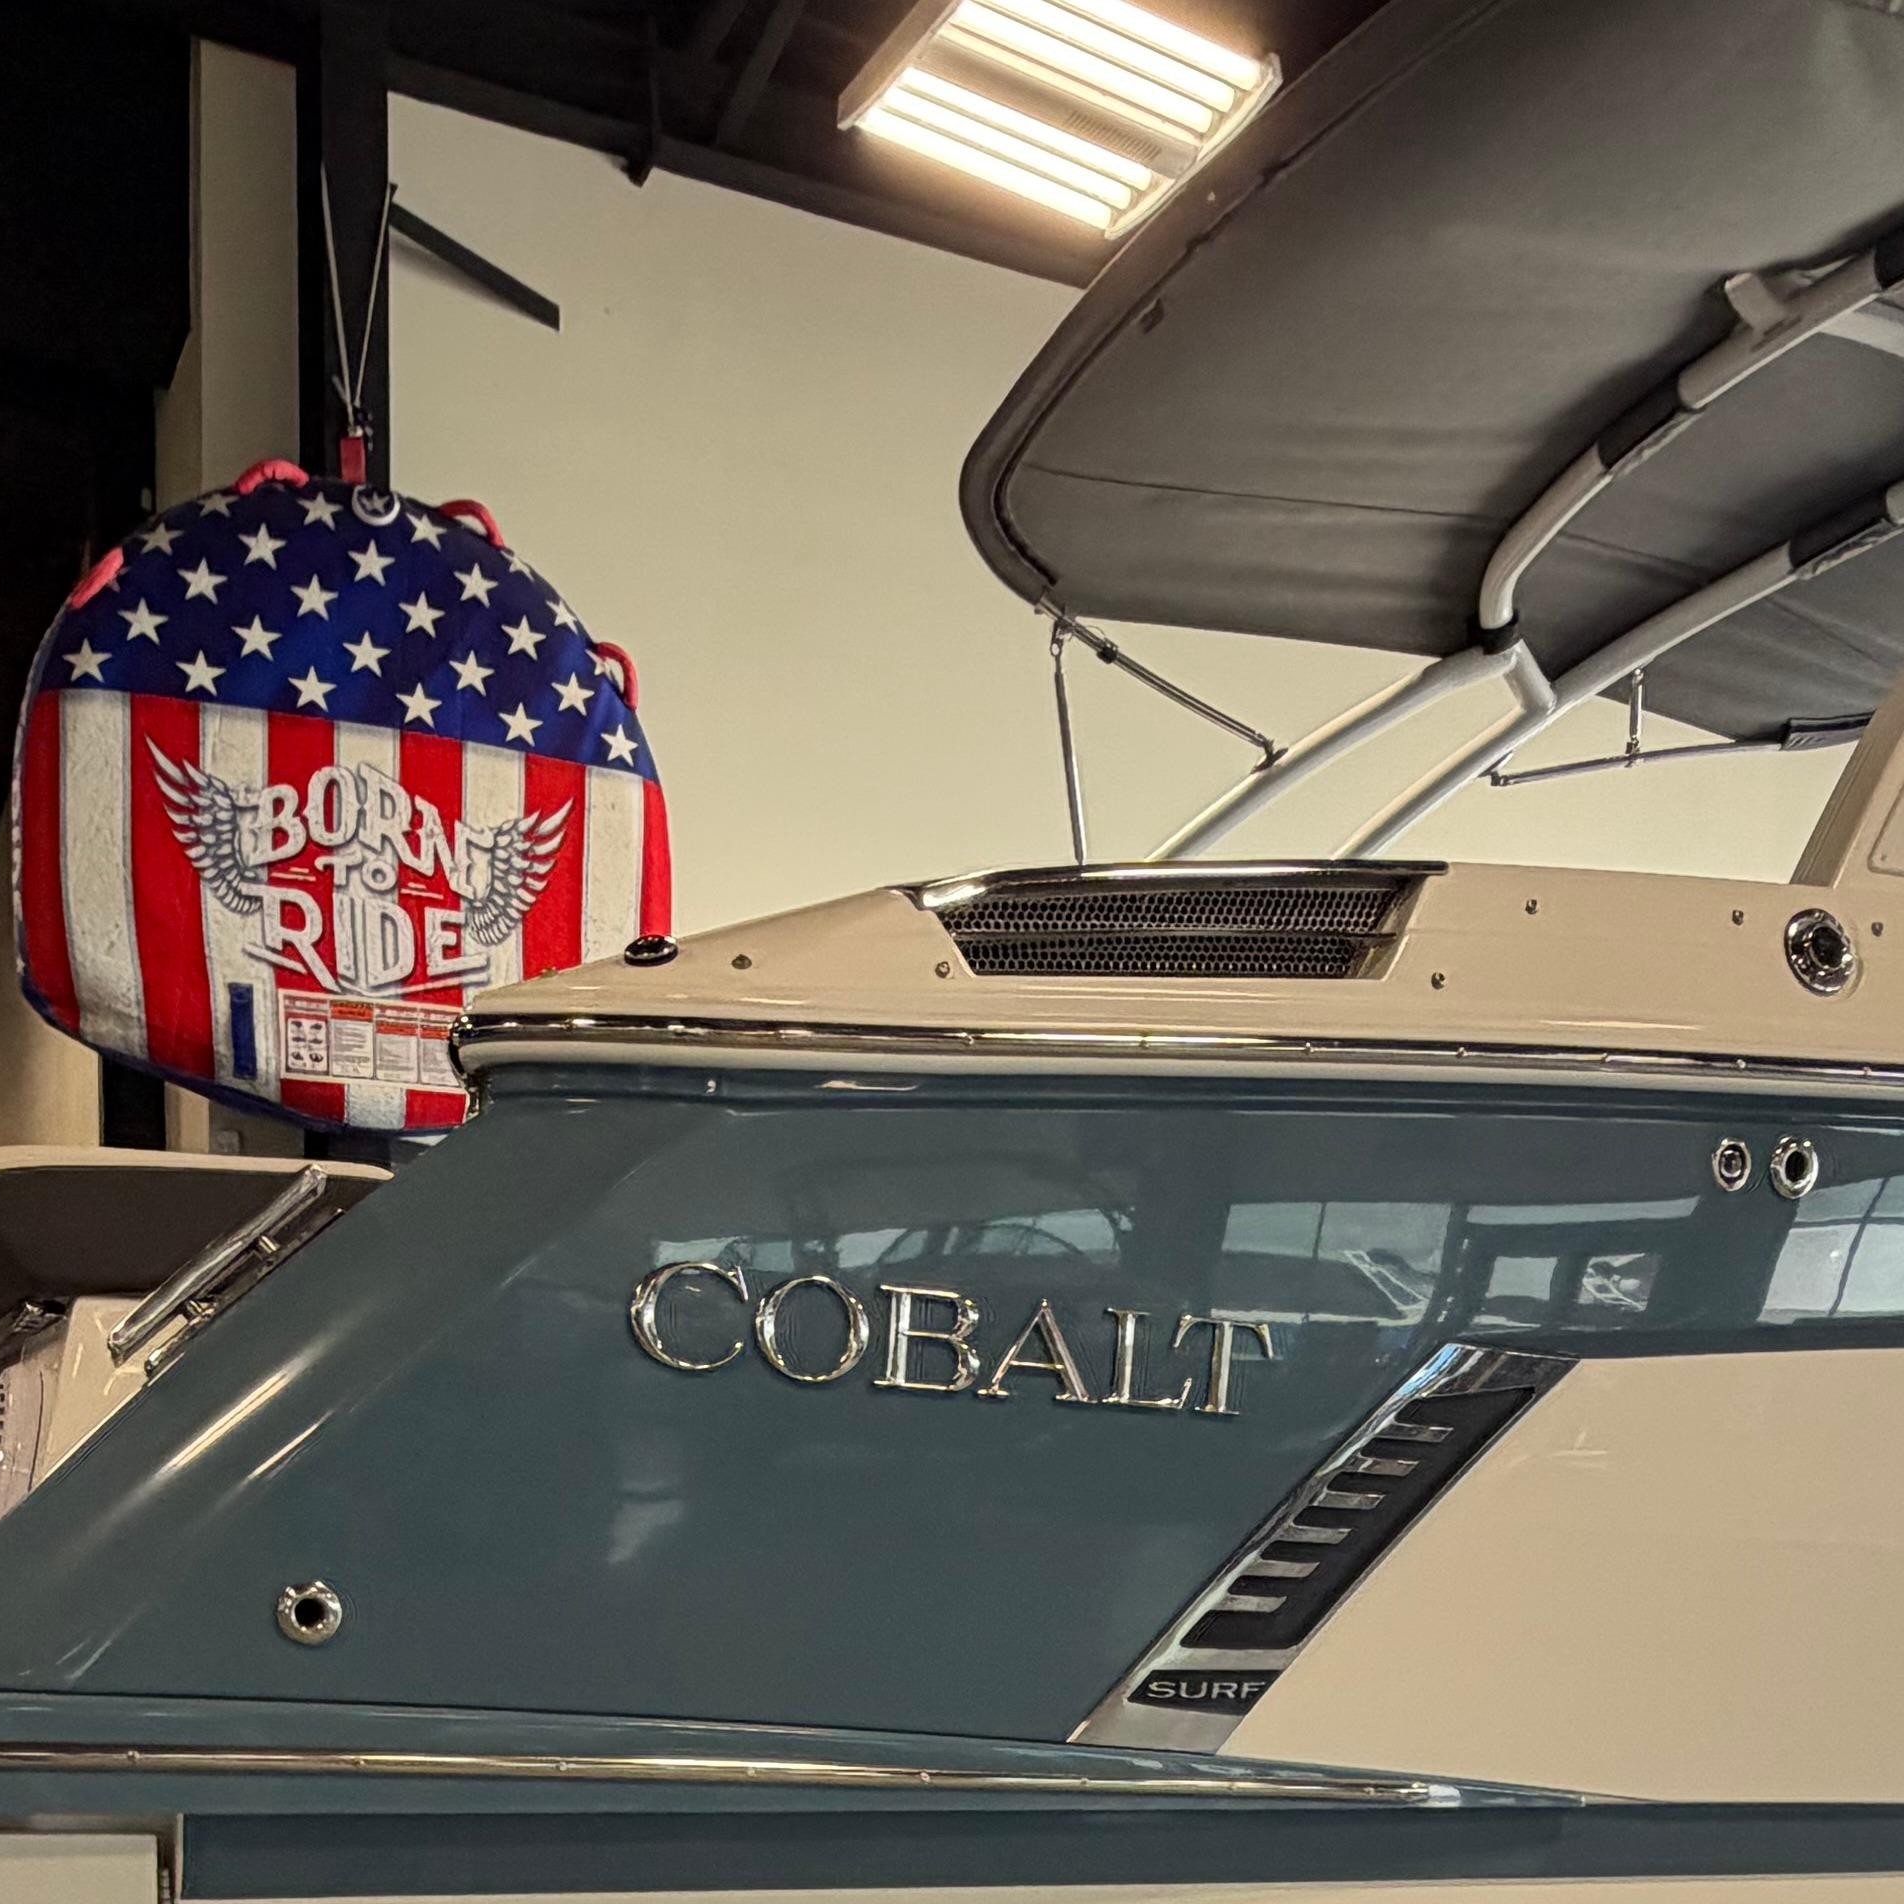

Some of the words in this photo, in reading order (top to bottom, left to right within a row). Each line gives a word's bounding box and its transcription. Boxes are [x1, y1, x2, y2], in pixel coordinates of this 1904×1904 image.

[230, 762, 495, 899] BORN
[315, 851, 397, 891] TO
[238, 881, 489, 992] RIDE
[629, 1260, 1276, 1416] COBALT
[1146, 1679, 1268, 1702] SURF
